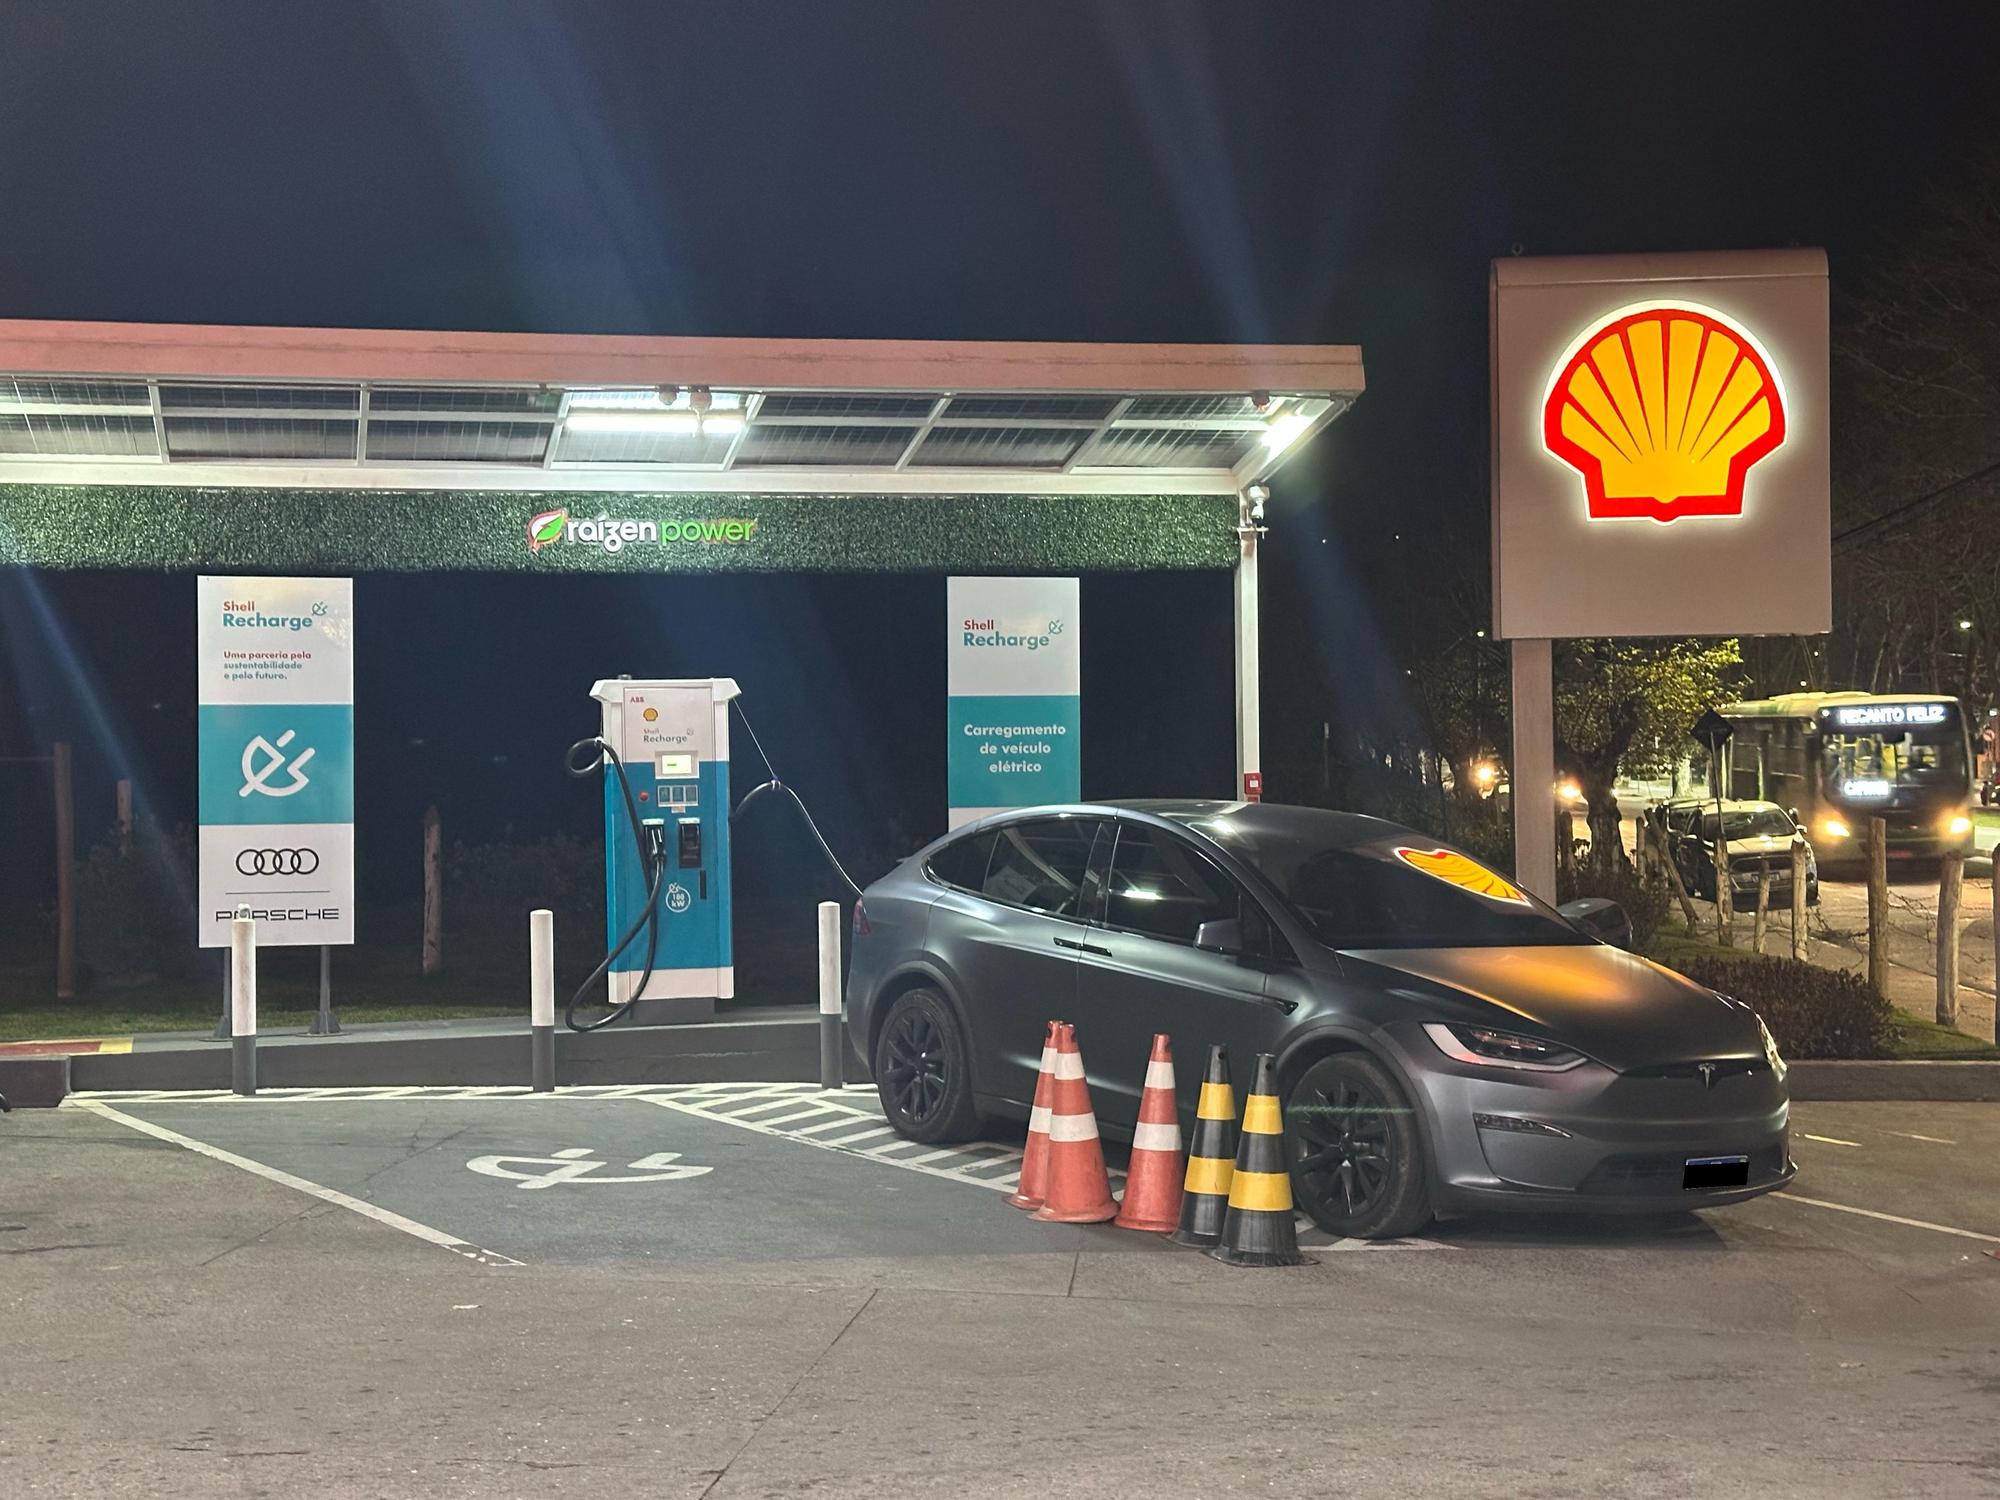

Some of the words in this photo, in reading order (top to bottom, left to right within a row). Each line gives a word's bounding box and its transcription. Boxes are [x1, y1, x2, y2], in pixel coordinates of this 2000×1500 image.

[567, 513, 657, 552] raízen
[661, 520, 754, 546] power
[223, 600, 255, 612] Shell
[223, 612, 313, 631] Recharge
[964, 619, 994, 630] Shell
[963, 631, 1049, 650] Recharge
[223, 651, 247, 659] Uma
[249, 651, 288, 661] parceria
[290, 651, 312, 661] pela
[224, 661, 303, 670] sustentabilidade
[224, 672, 230, 680] e
[232, 671, 254, 681] pelo
[255, 671, 288, 681] futuro.
[964, 724, 1066, 738] Carregamento
[643, 734, 688, 744] Recharge
[980, 742, 998, 754] de
[1002, 741, 1051, 754] veículo
[989, 760, 1042, 773] elétrico
